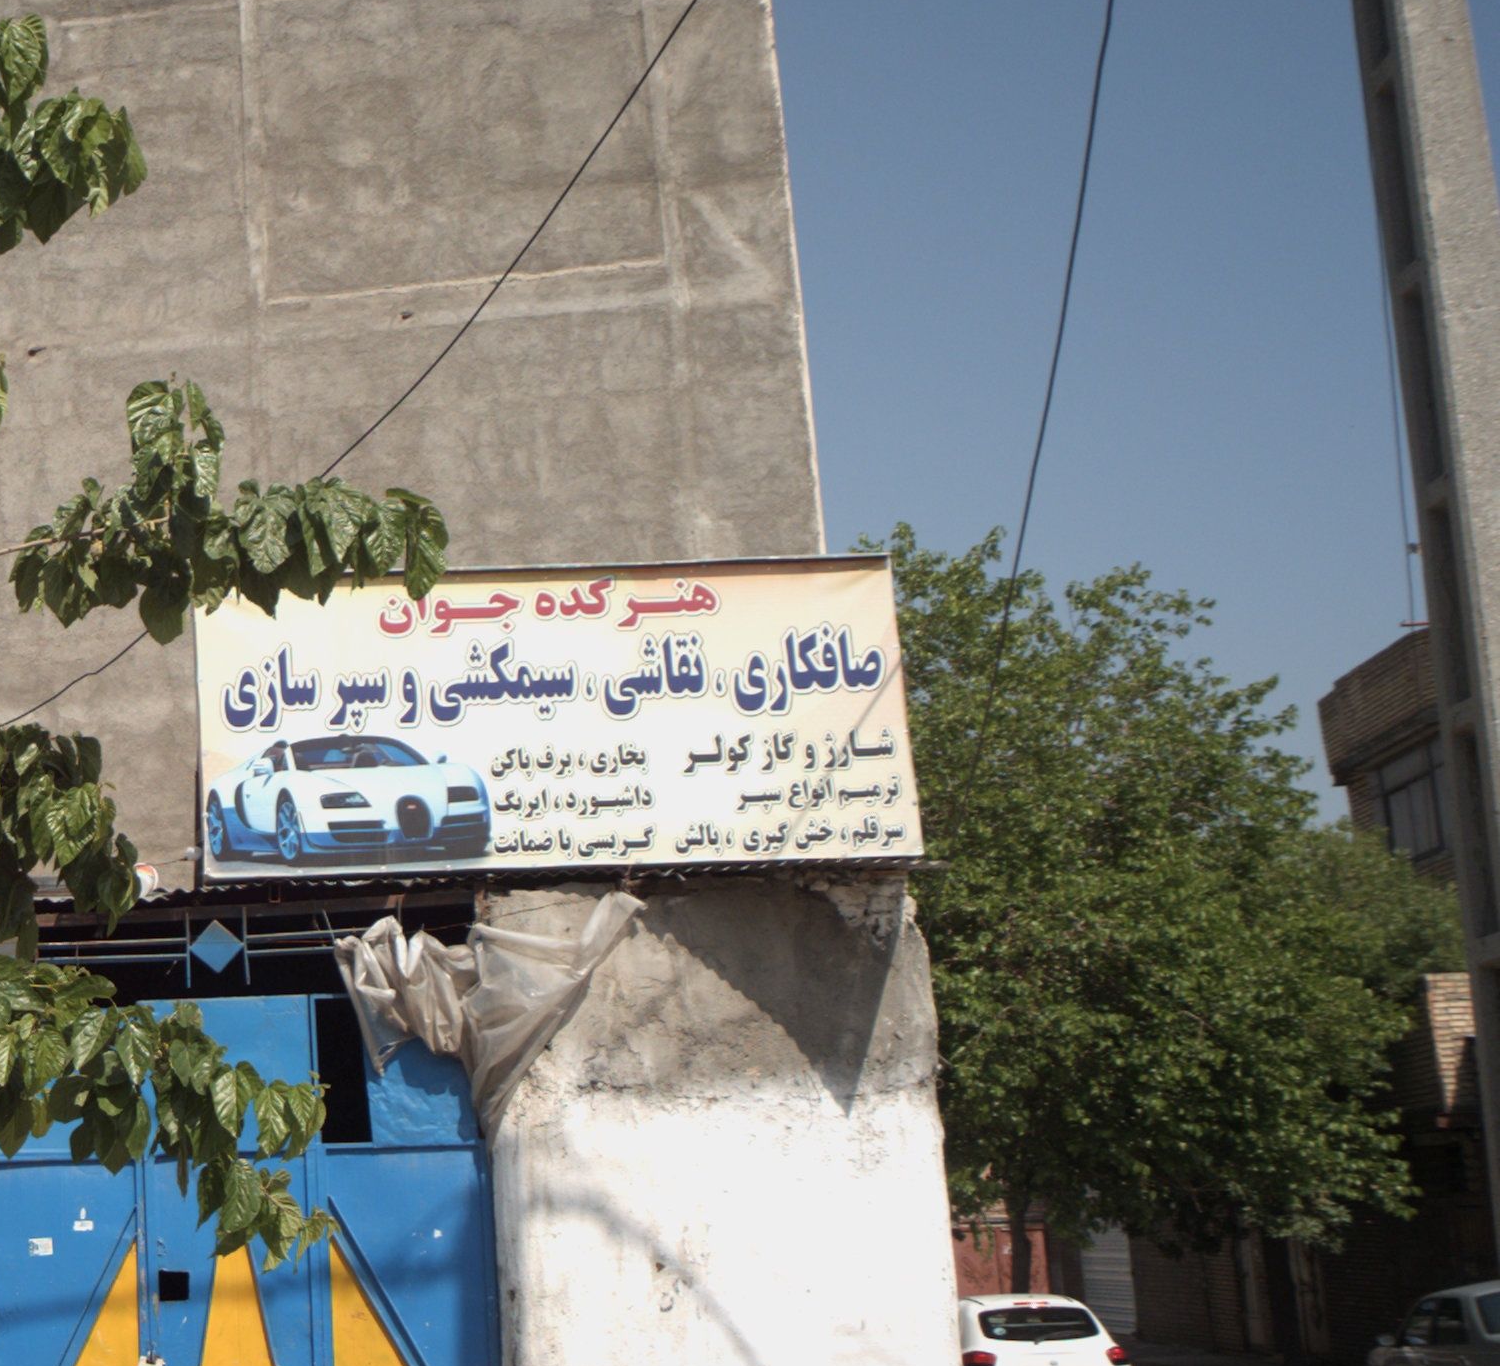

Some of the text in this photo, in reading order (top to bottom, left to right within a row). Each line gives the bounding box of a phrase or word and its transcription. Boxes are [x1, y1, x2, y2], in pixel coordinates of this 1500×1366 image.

[377, 590, 523, 636] جوان
[223, 645, 317, 728] سازی
[328, 671, 388, 729] سپر
[398, 668, 420, 727] و
[428, 640, 575, 723] سیمکشی
[683, 727, 894, 776] شارژ و گاز کولر
[736, 774, 900, 813] ترمیم انواع سپر
[493, 828, 555, 855] ضمانت
[557, 828, 573, 859] با
[675, 822, 722, 856] پالش
[795, 819, 835, 851] خش
